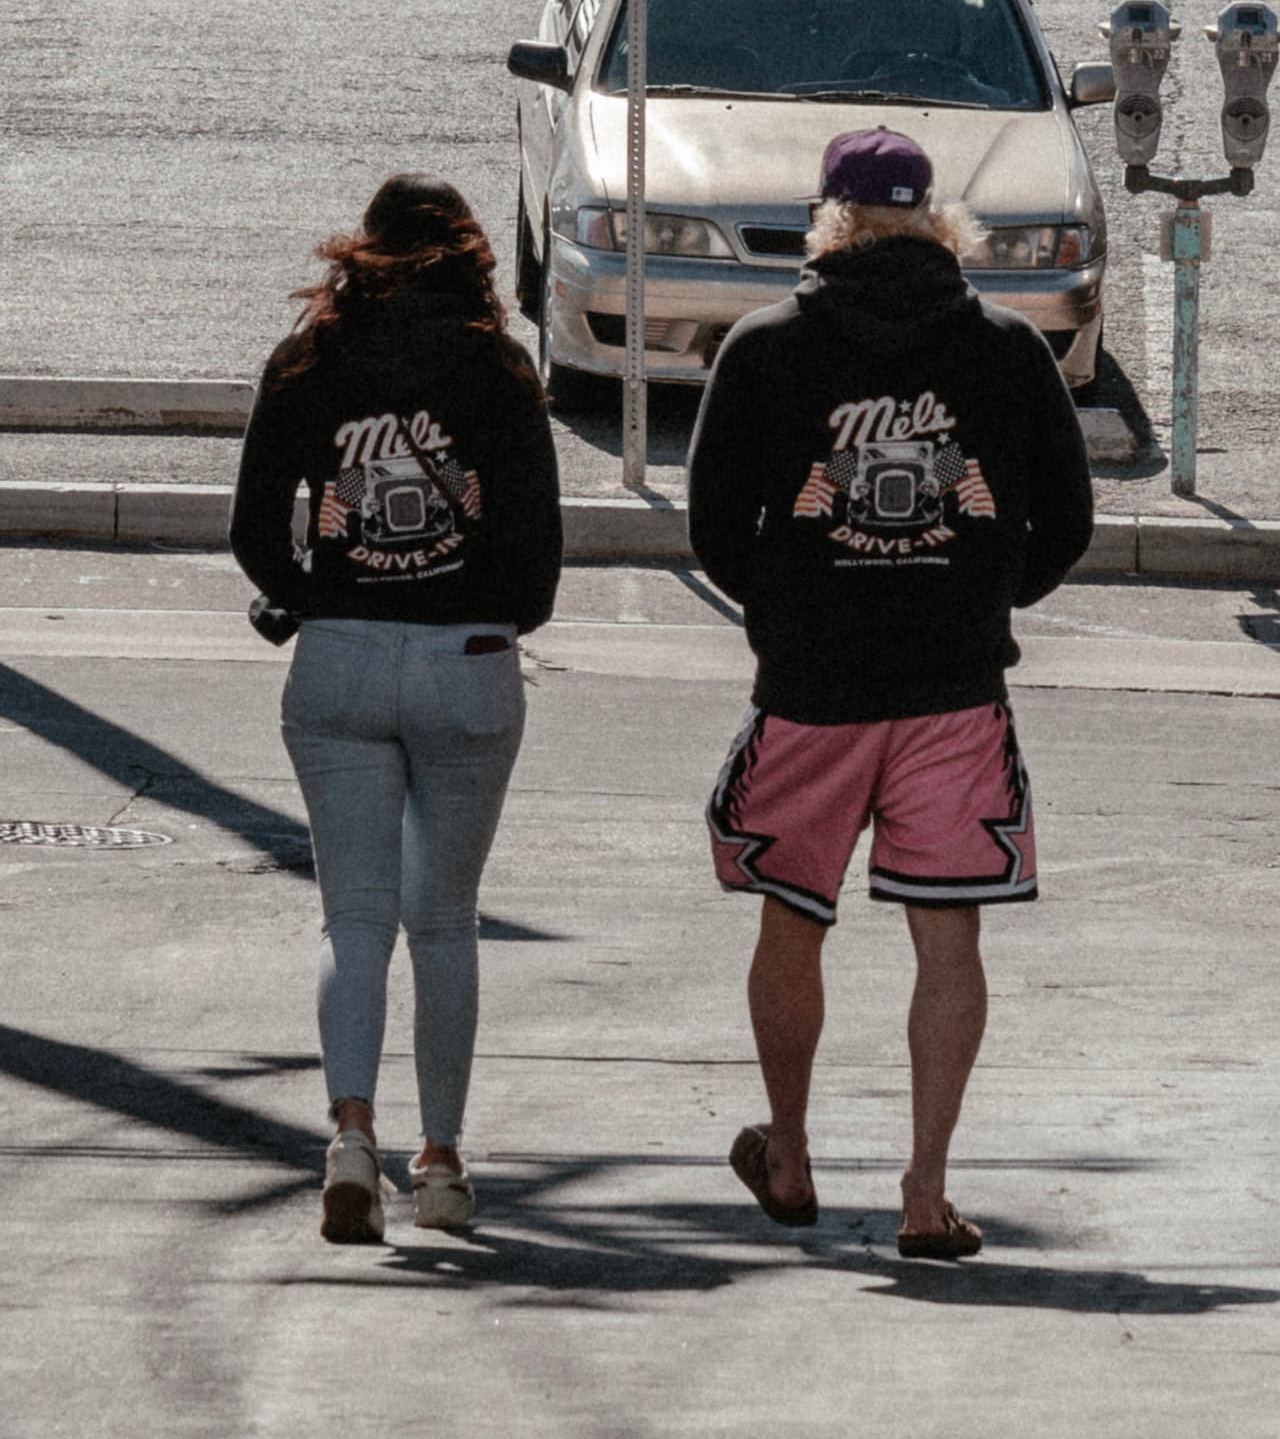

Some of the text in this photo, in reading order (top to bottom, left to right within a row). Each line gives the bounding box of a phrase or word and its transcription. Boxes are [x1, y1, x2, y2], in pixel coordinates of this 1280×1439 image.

[829, 391, 958, 451] Mels
[347, 532, 465, 570] DRIVE-IN
[828, 524, 957, 554] DRIVE-IN
